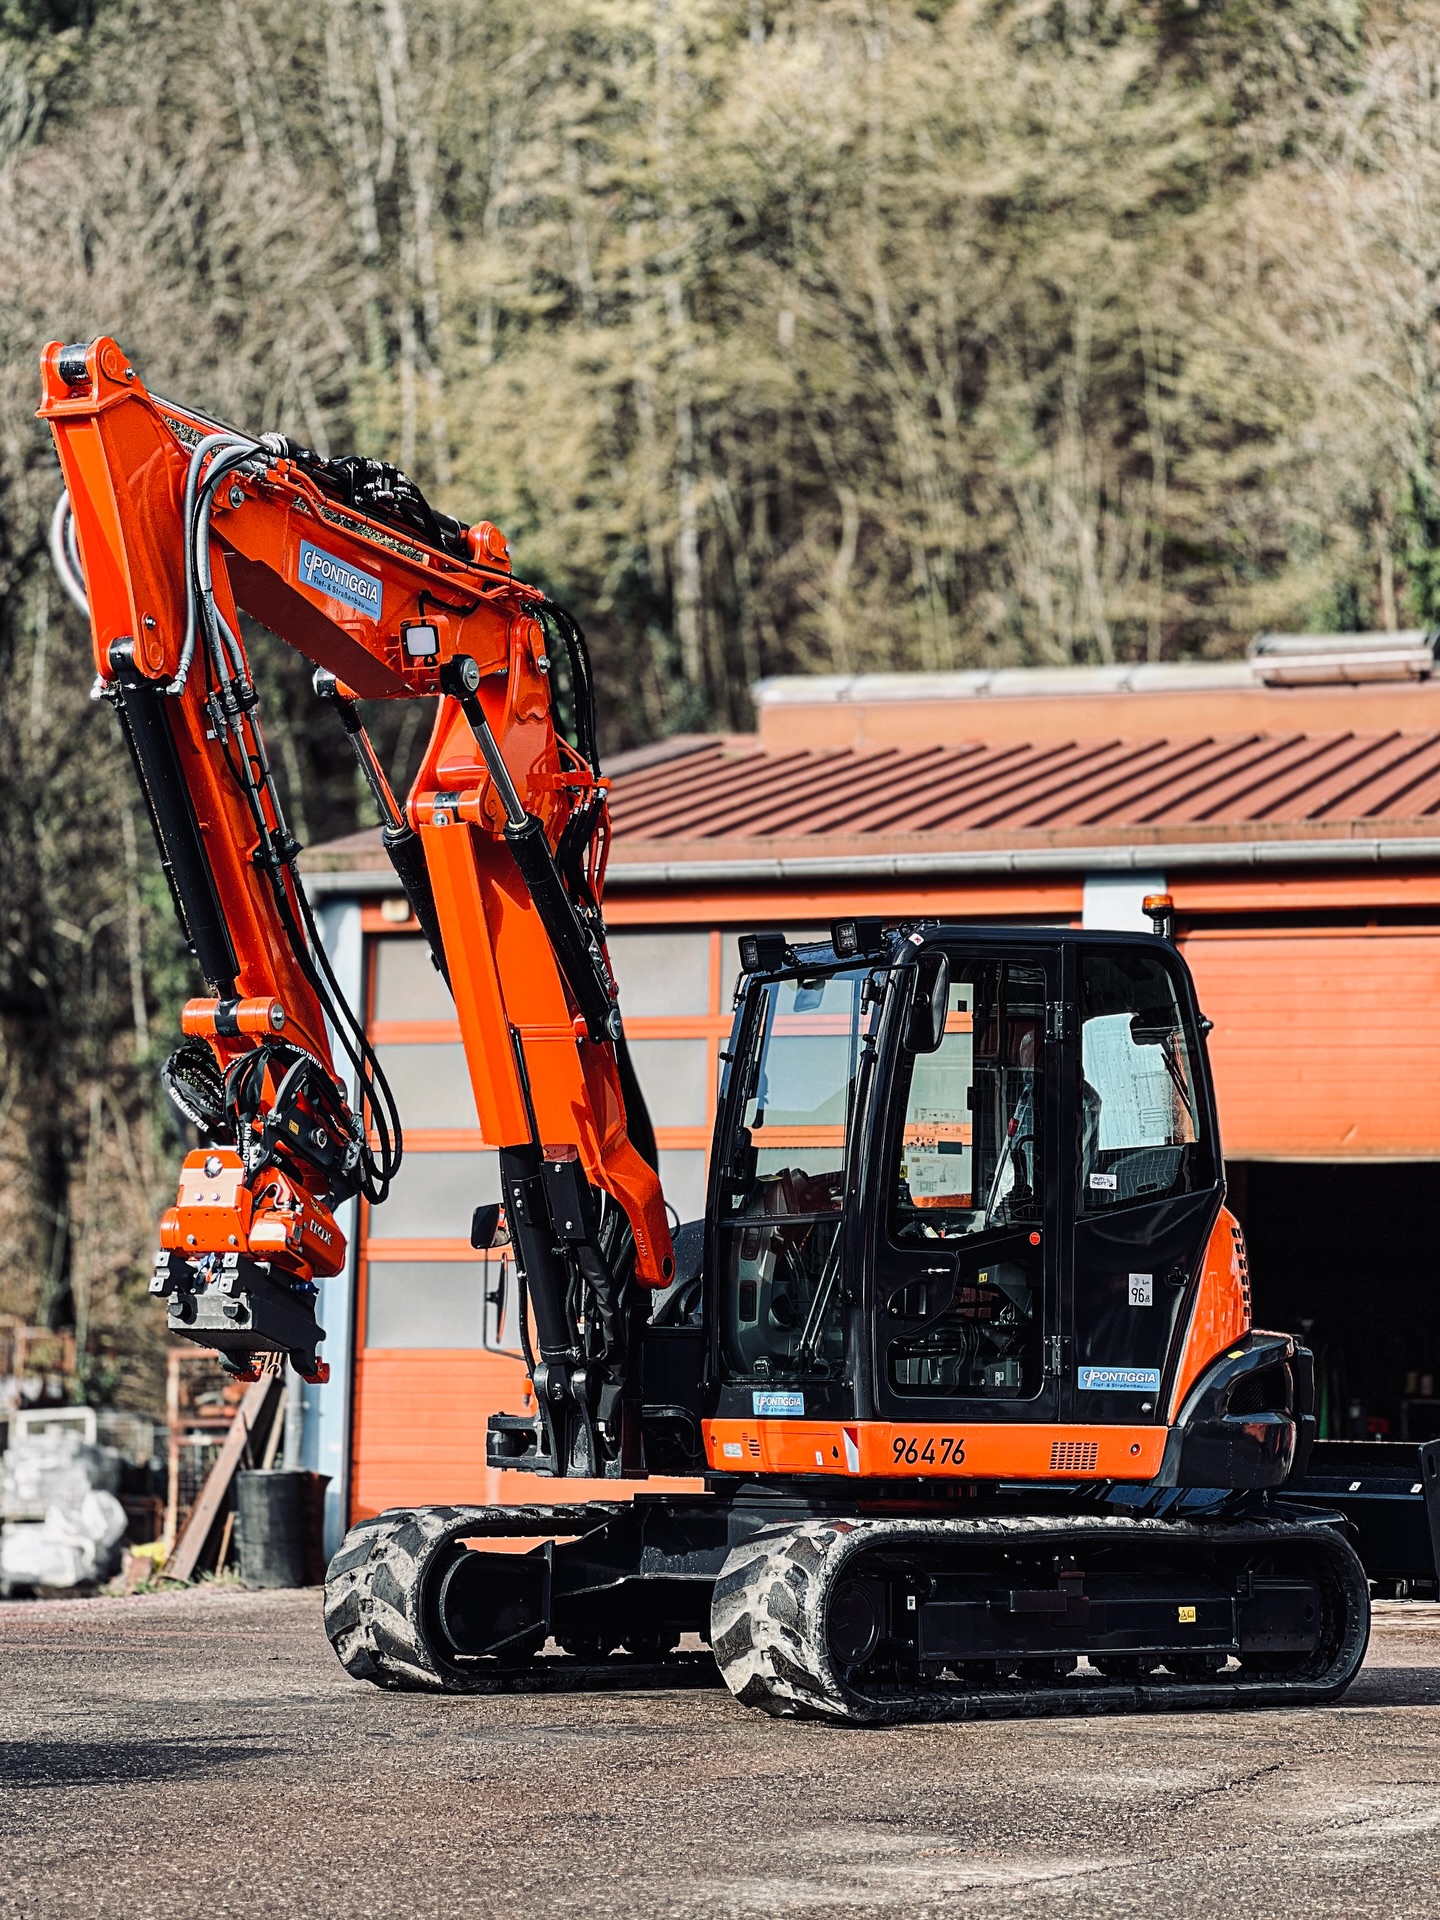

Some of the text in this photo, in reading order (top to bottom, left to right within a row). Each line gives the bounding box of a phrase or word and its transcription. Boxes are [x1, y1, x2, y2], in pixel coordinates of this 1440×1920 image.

[168, 1086, 210, 1133] KINSHOFER
[1131, 1287, 1145, 1303] 96
[893, 1437, 965, 1465] 96476
